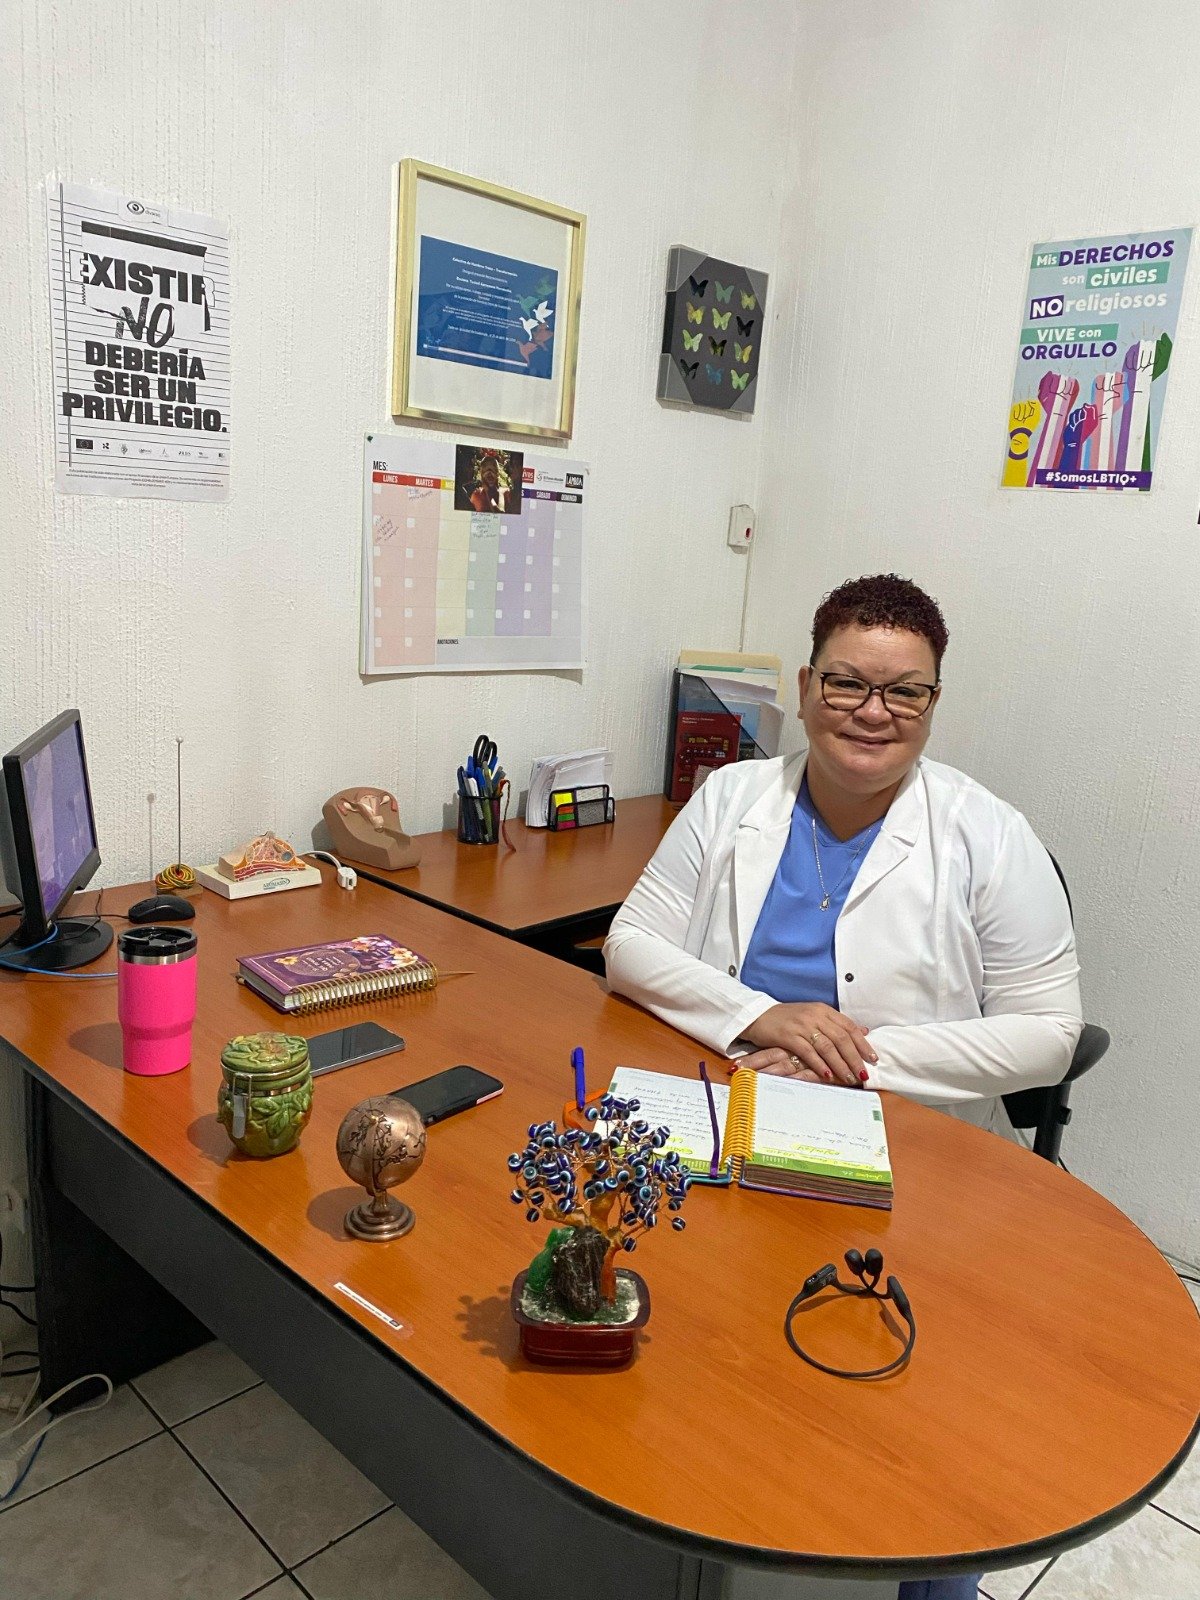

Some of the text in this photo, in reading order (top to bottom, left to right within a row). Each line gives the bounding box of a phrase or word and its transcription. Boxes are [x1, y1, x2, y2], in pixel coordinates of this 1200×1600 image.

[1037, 240, 1174, 266] Mis DERECHOS
[69, 249, 215, 307] EXISTIR
[1062, 267, 1157, 287] son civiles
[1032, 293, 1167, 318] NO religiosos
[115, 297, 175, 348] NO
[1037, 328, 1101, 342] VIVE con
[85, 340, 206, 380] DEBERÍA
[1022, 342, 1117, 360] ORGULLO
[94, 370, 196, 404] SER UN
[62, 392, 227, 433] PRIVILEGIO.
[382, 475, 398, 483] LUNES
[415, 478, 434, 487] MARTES
[1045, 472, 1136, 485] #SomosLBTIQ+
